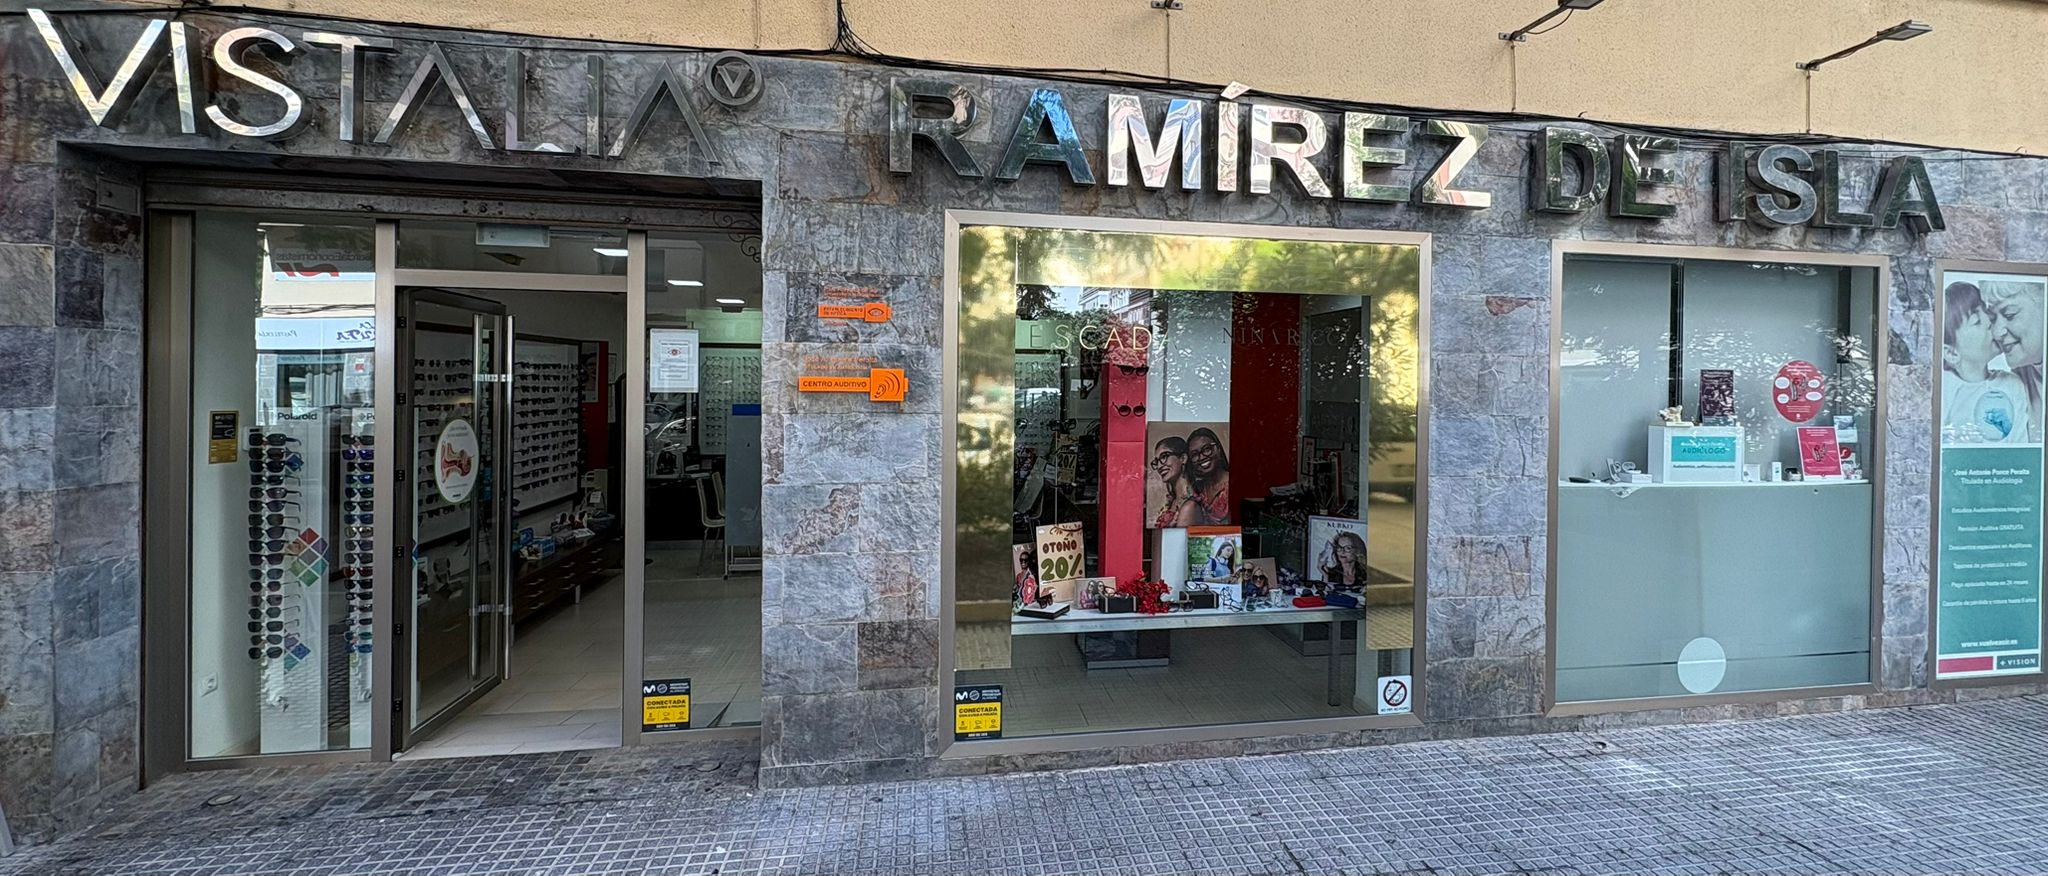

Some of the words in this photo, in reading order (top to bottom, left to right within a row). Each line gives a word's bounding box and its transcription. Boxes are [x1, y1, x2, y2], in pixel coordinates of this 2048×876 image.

[27, 8, 720, 165] VISTALIA
[889, 77, 1491, 208] RAMÍREZ
[1538, 126, 1680, 218] DE
[1720, 141, 1946, 233] ISLA
[1029, 324, 1178, 352] ESCADA
[803, 380, 833, 388] CENTRO
[277, 412, 318, 420] Polaroid
[1042, 537, 1077, 555] OTOÑO
[1041, 552, 1082, 581] 20%
[646, 699, 686, 707] CONECTADA
[958, 706, 998, 714] CONECTADA
